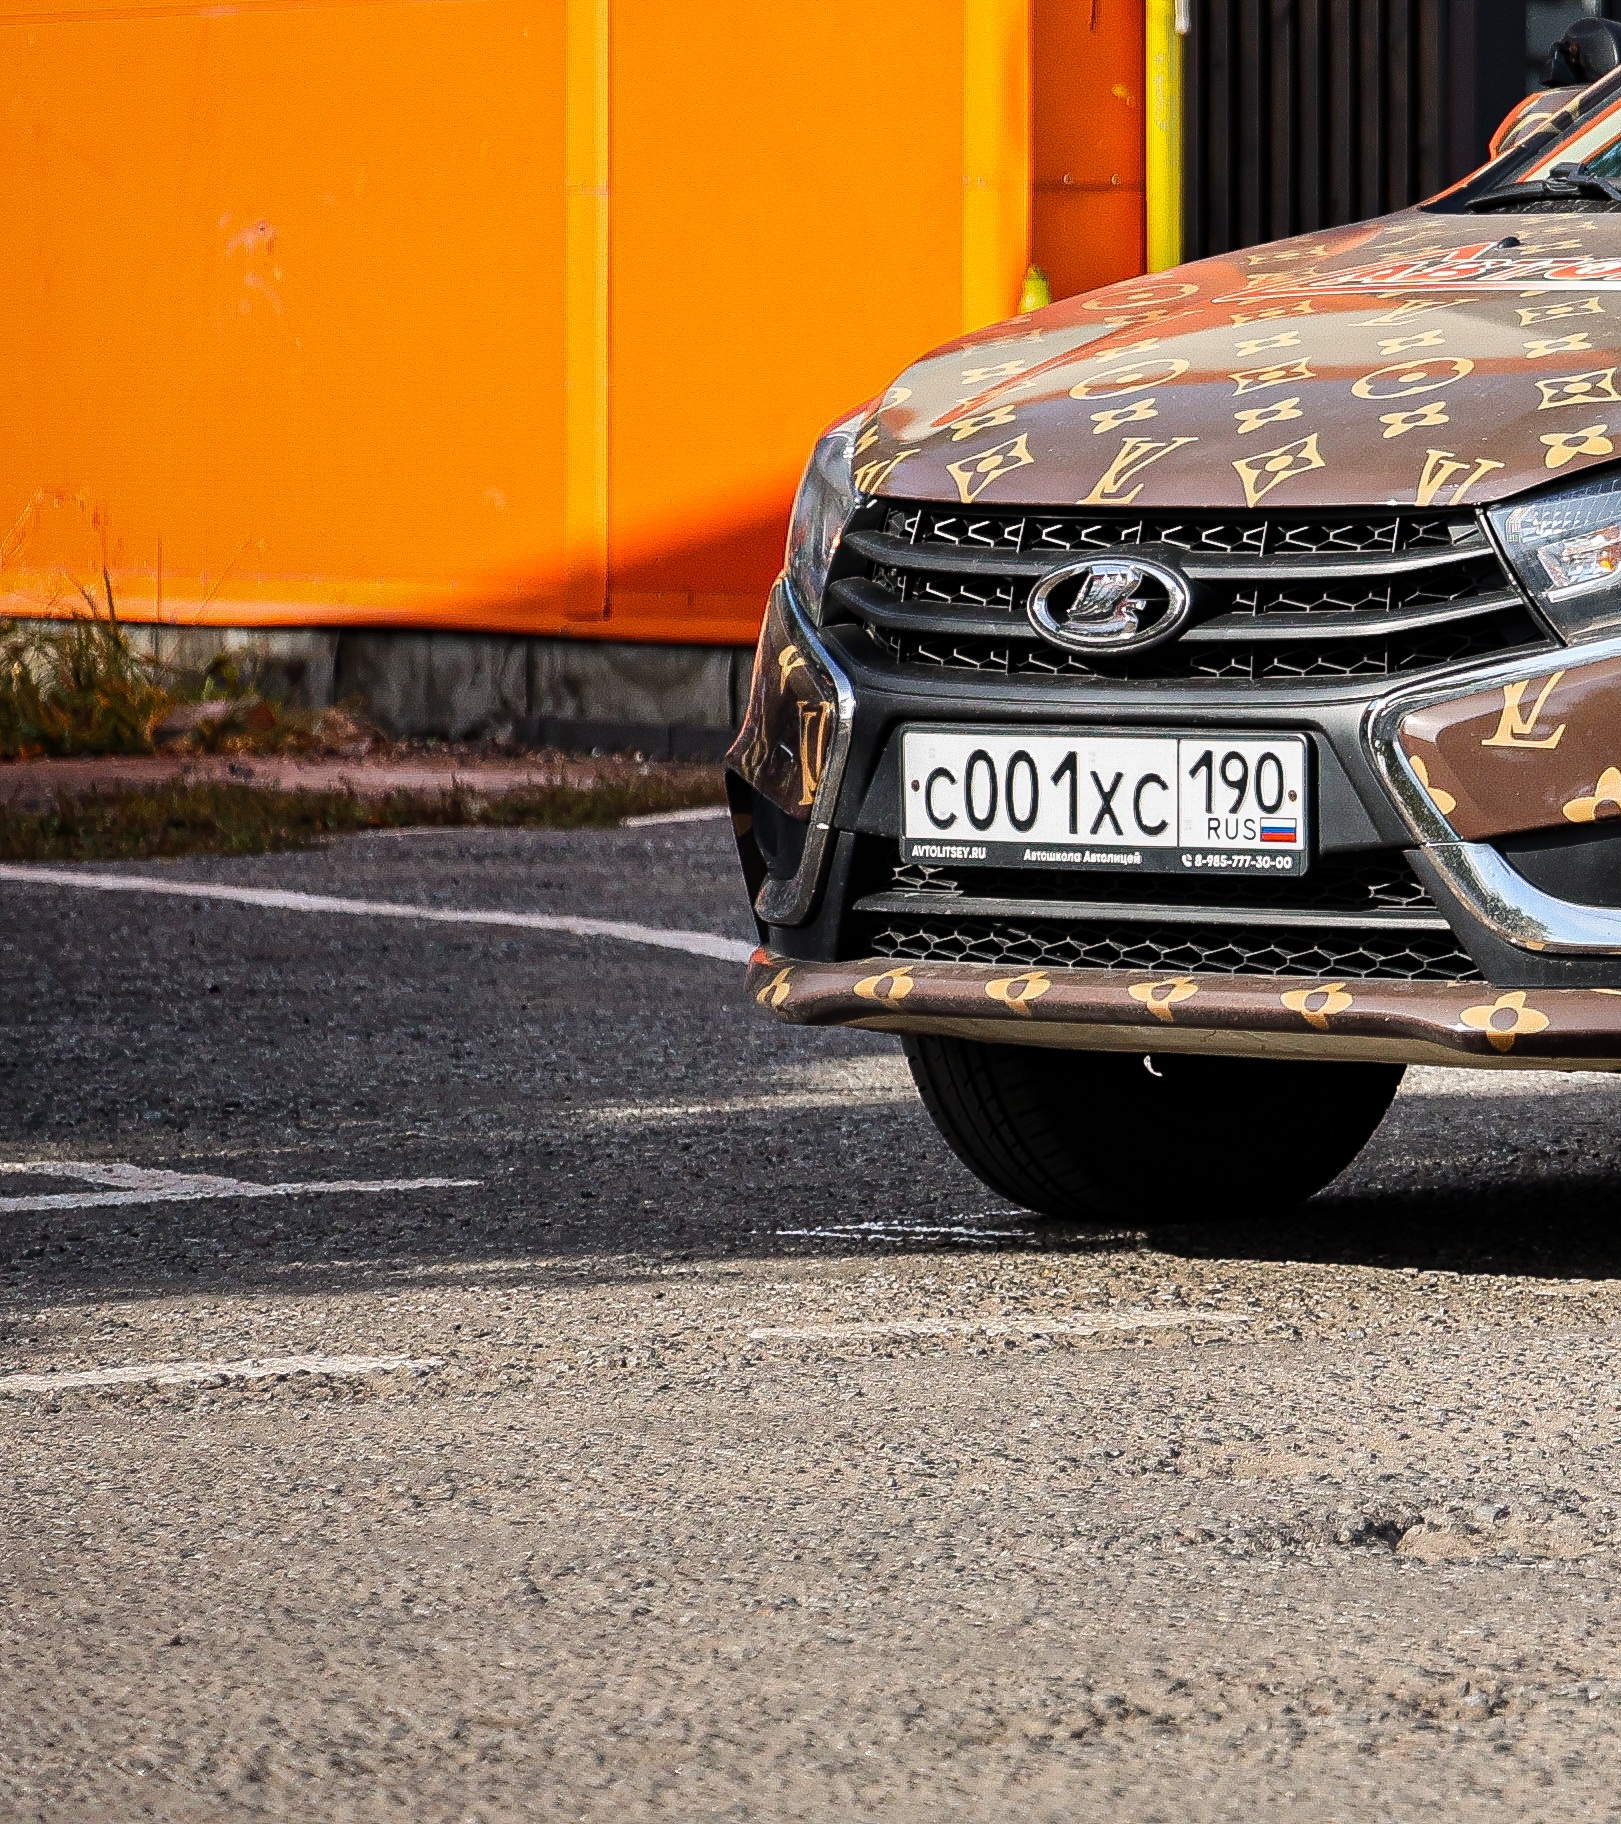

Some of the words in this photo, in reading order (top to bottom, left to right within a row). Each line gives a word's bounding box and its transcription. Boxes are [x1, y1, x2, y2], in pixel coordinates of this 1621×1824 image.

[1188, 749, 1285, 815] 190
[1207, 817, 1257, 841] RUS
[911, 845, 987, 860] AVTOLITSEY.RU
[1023, 848, 1081, 863] Автошкола
[1082, 850, 1142, 865] Автолицей
[1194, 853, 1292, 869] 8-985-777-30-00
